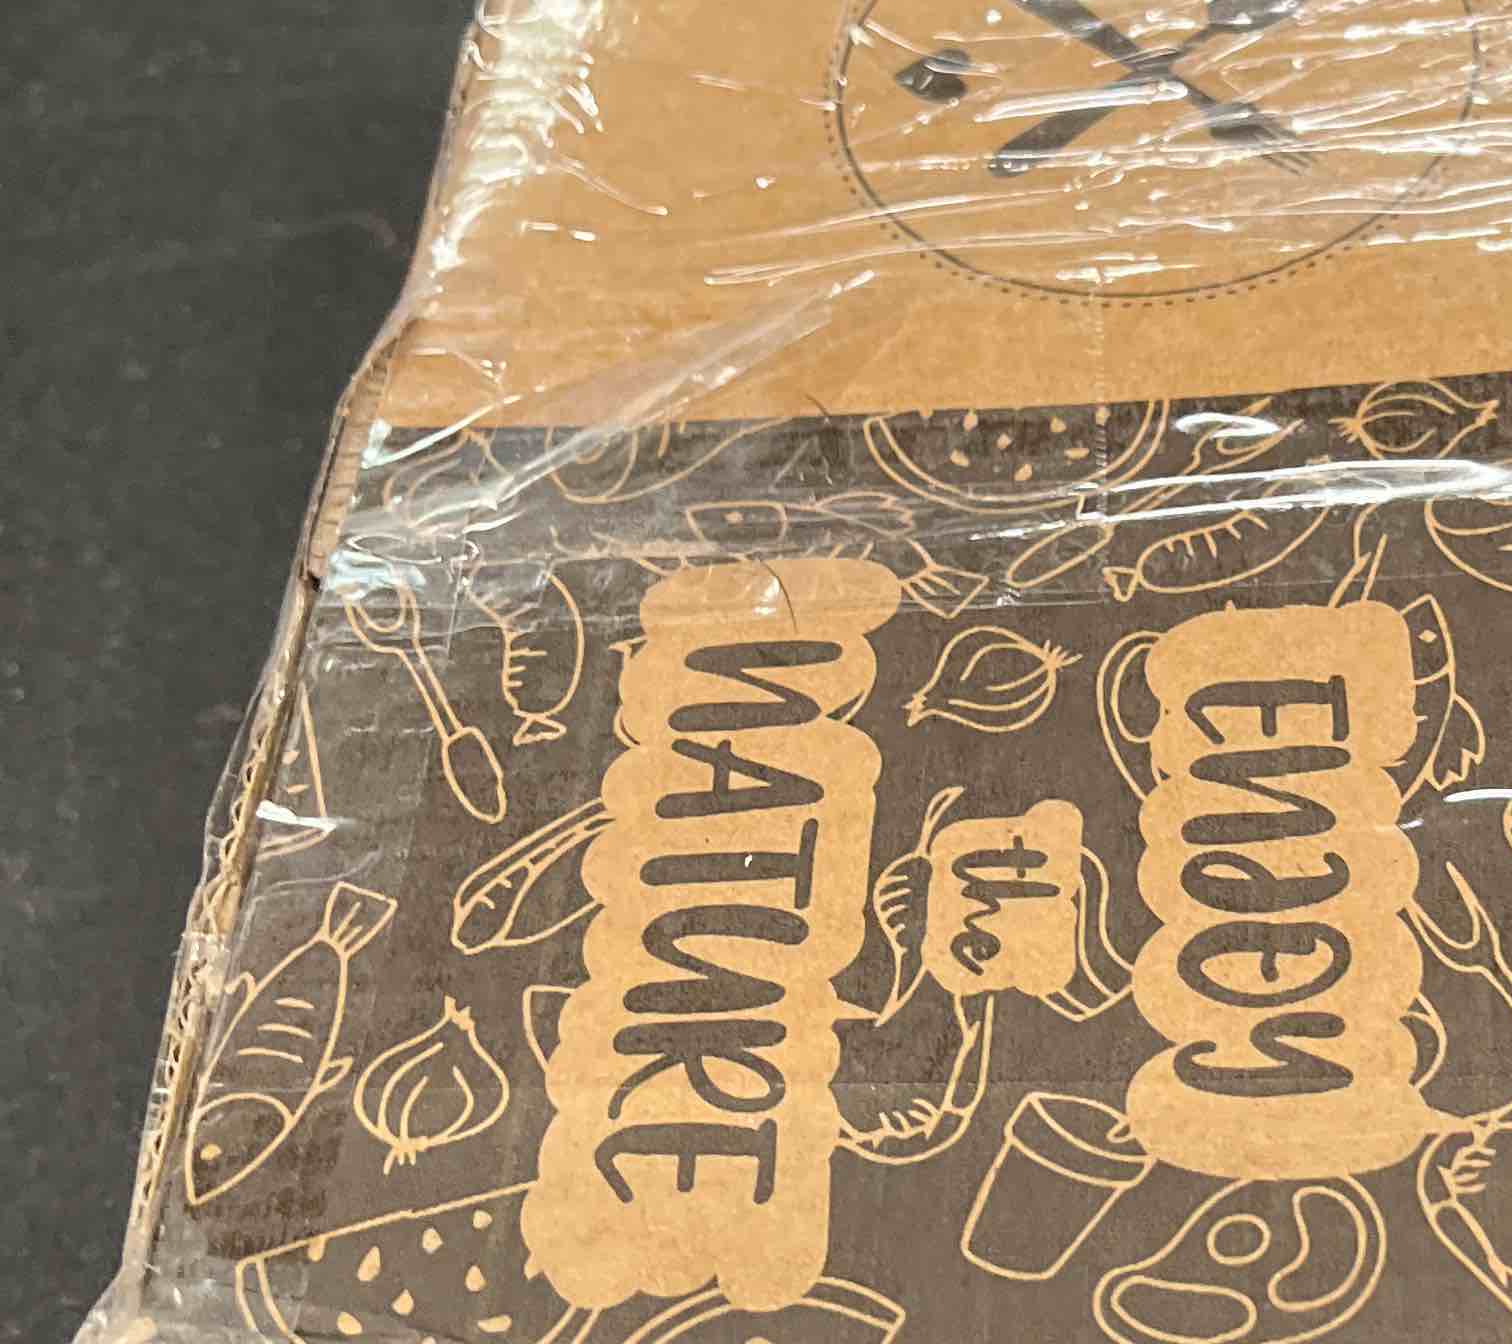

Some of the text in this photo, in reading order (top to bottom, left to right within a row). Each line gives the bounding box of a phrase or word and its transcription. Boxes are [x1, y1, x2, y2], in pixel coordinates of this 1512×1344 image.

[593, 637, 845, 1207] NATURE
[950, 833, 1061, 975] the
[1172, 672, 1353, 1098] ENJOY
